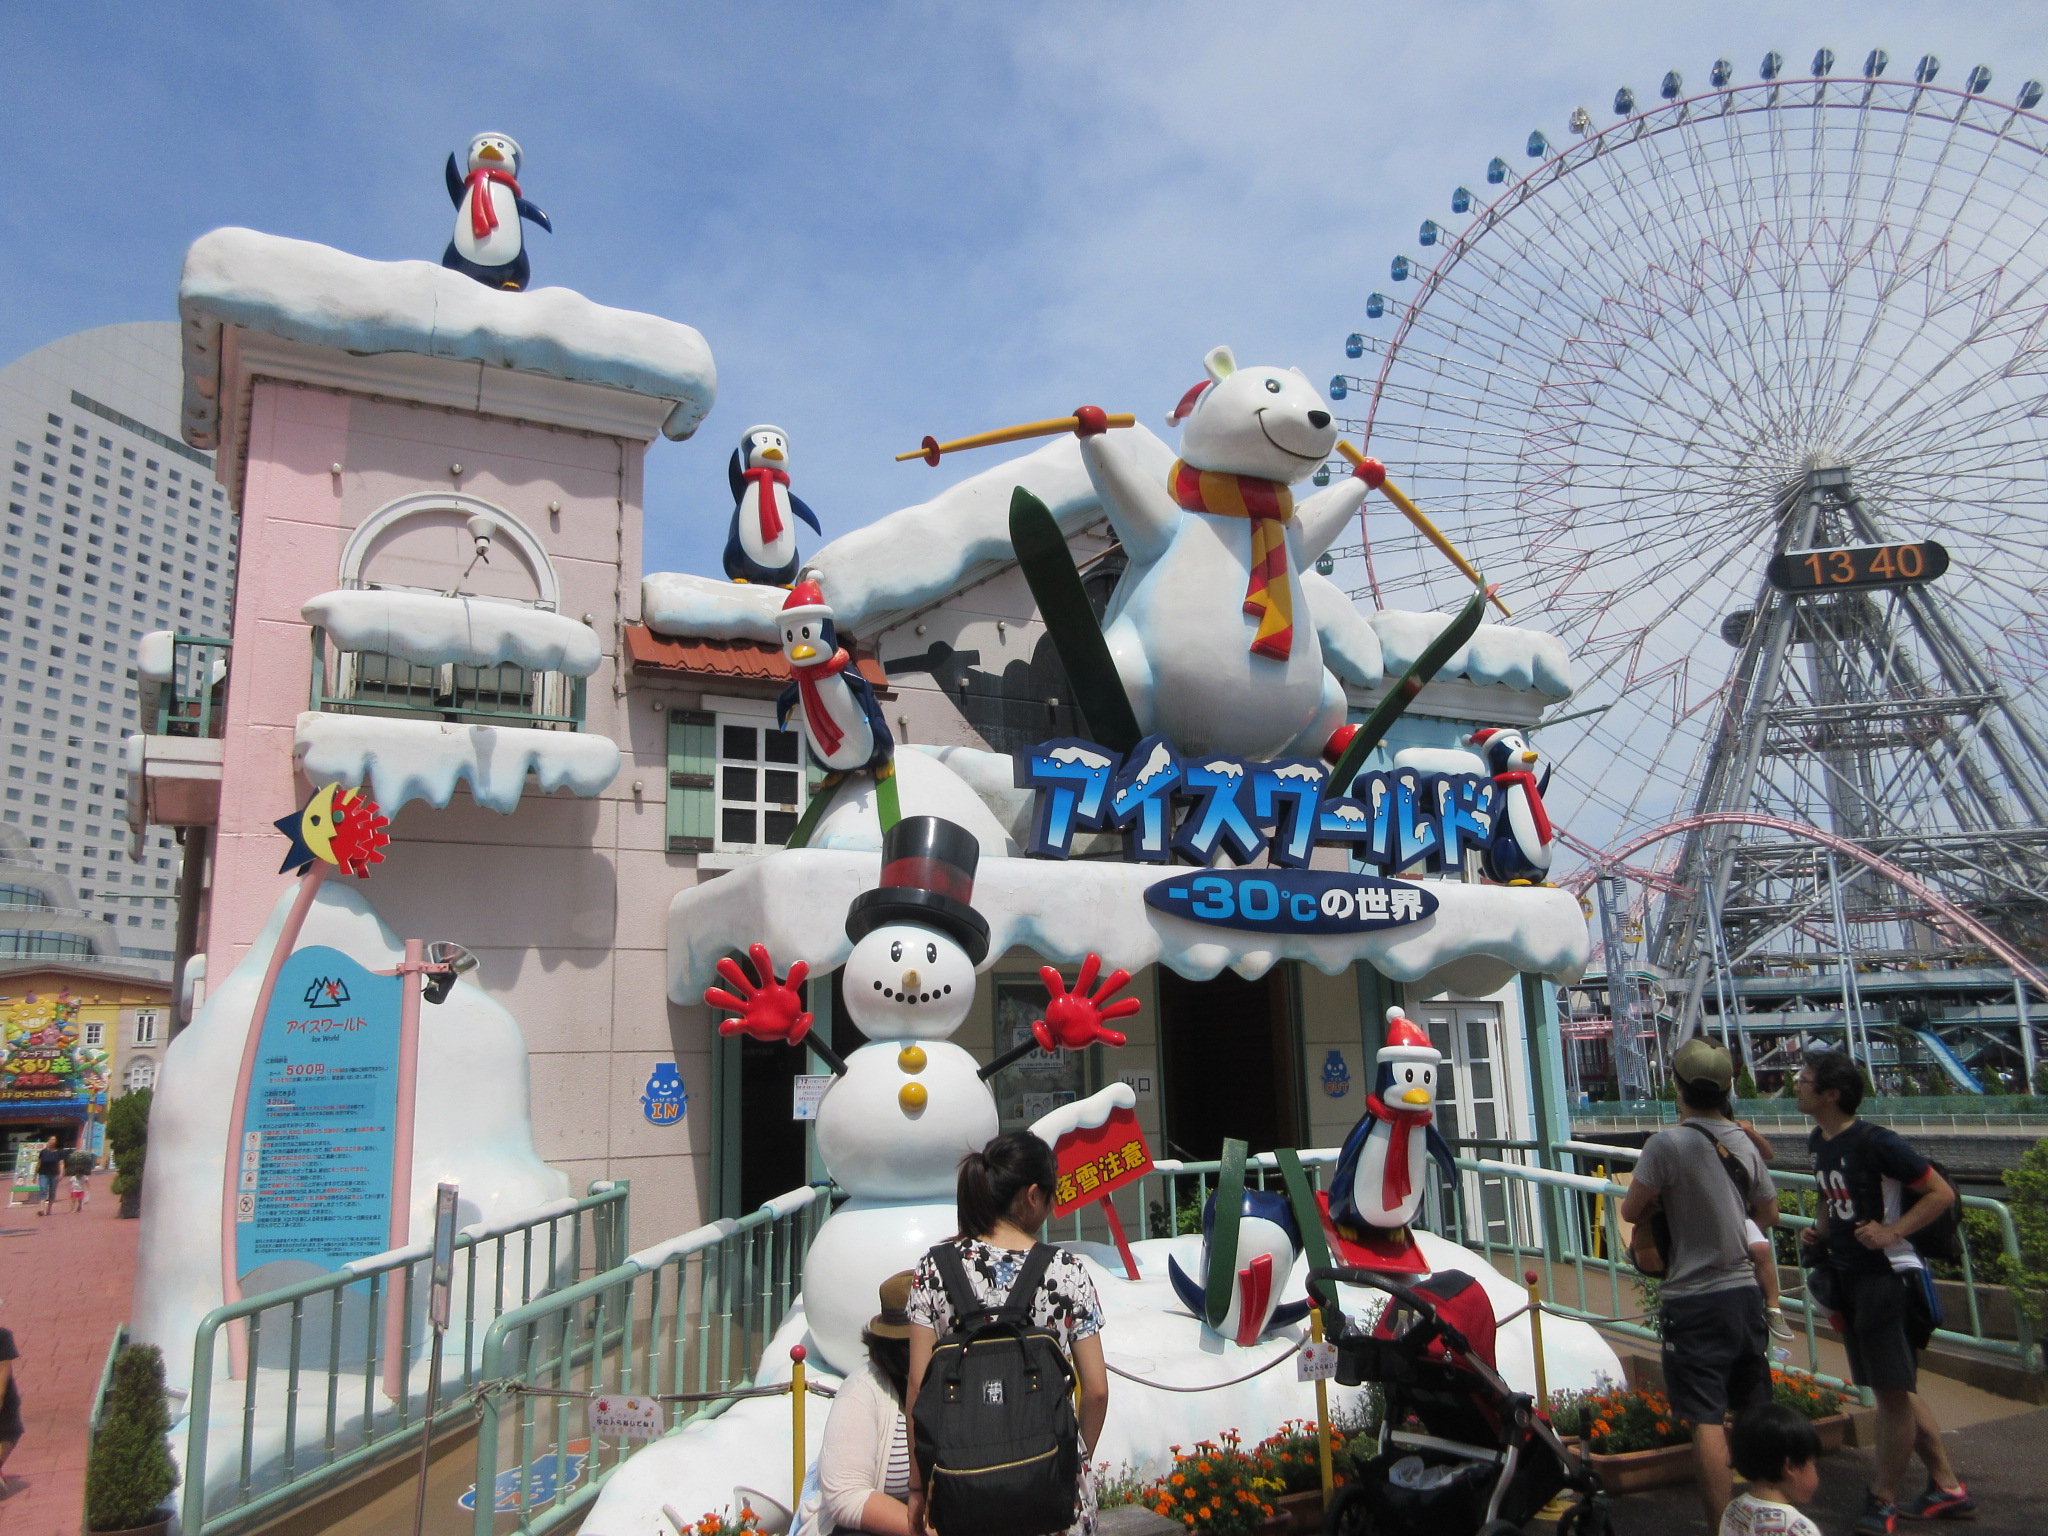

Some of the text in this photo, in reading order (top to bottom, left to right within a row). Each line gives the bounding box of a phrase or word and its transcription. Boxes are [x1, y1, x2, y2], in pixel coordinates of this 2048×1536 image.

[1804, 545, 1924, 585] 13 40
[1028, 740, 1495, 869] アイスワールド
[286, 1016, 368, 1034] アイスワールド
[322, 1034, 340, 1042] World
[286, 1063, 325, 1076] 500円
[1325, 1081, 1349, 1093] OUT
[652, 1103, 679, 1118] IN
[1055, 1140, 1147, 1206] 落雪注意
[1816, 1170, 1854, 1219] 10
